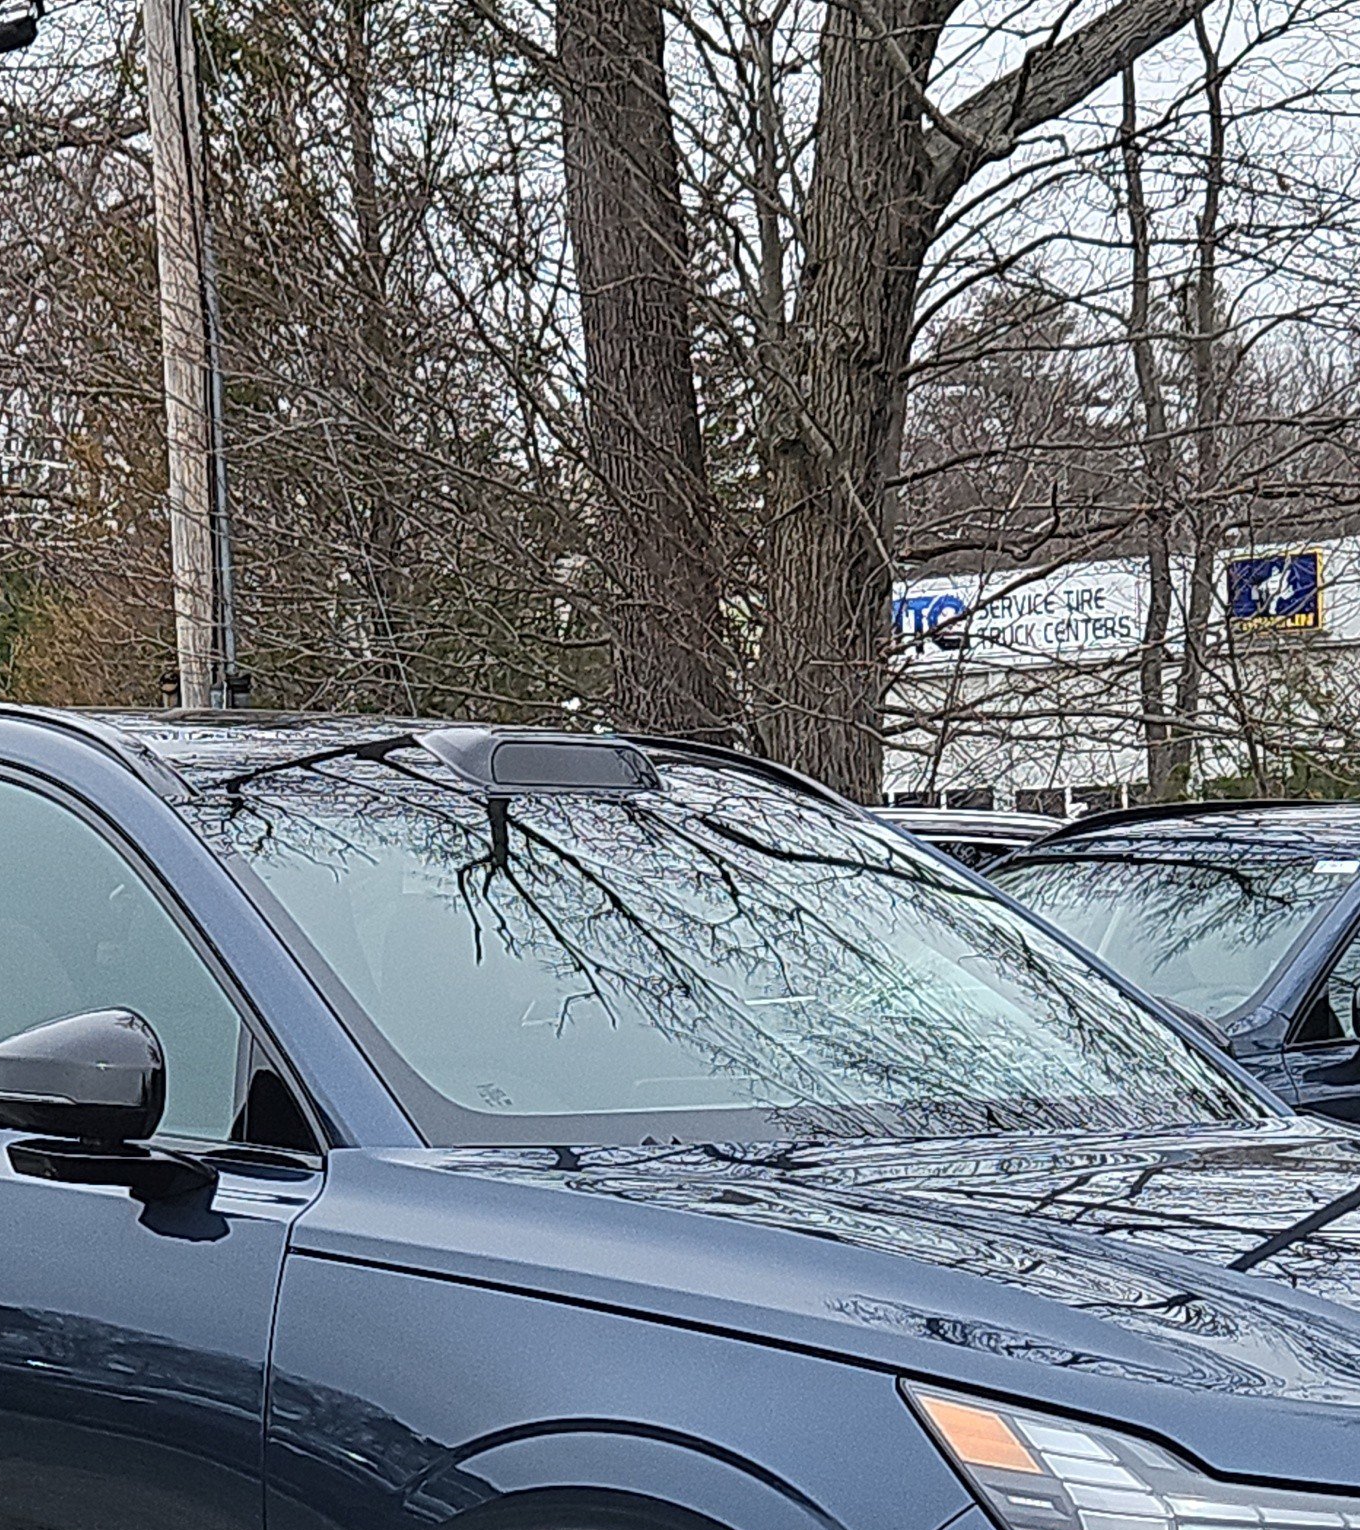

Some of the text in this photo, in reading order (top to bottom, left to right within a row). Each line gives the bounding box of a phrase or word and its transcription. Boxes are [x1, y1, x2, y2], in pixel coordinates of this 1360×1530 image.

[1064, 588, 1106, 612] TIRE
[977, 616, 1130, 650] TRUCK CENTERS
